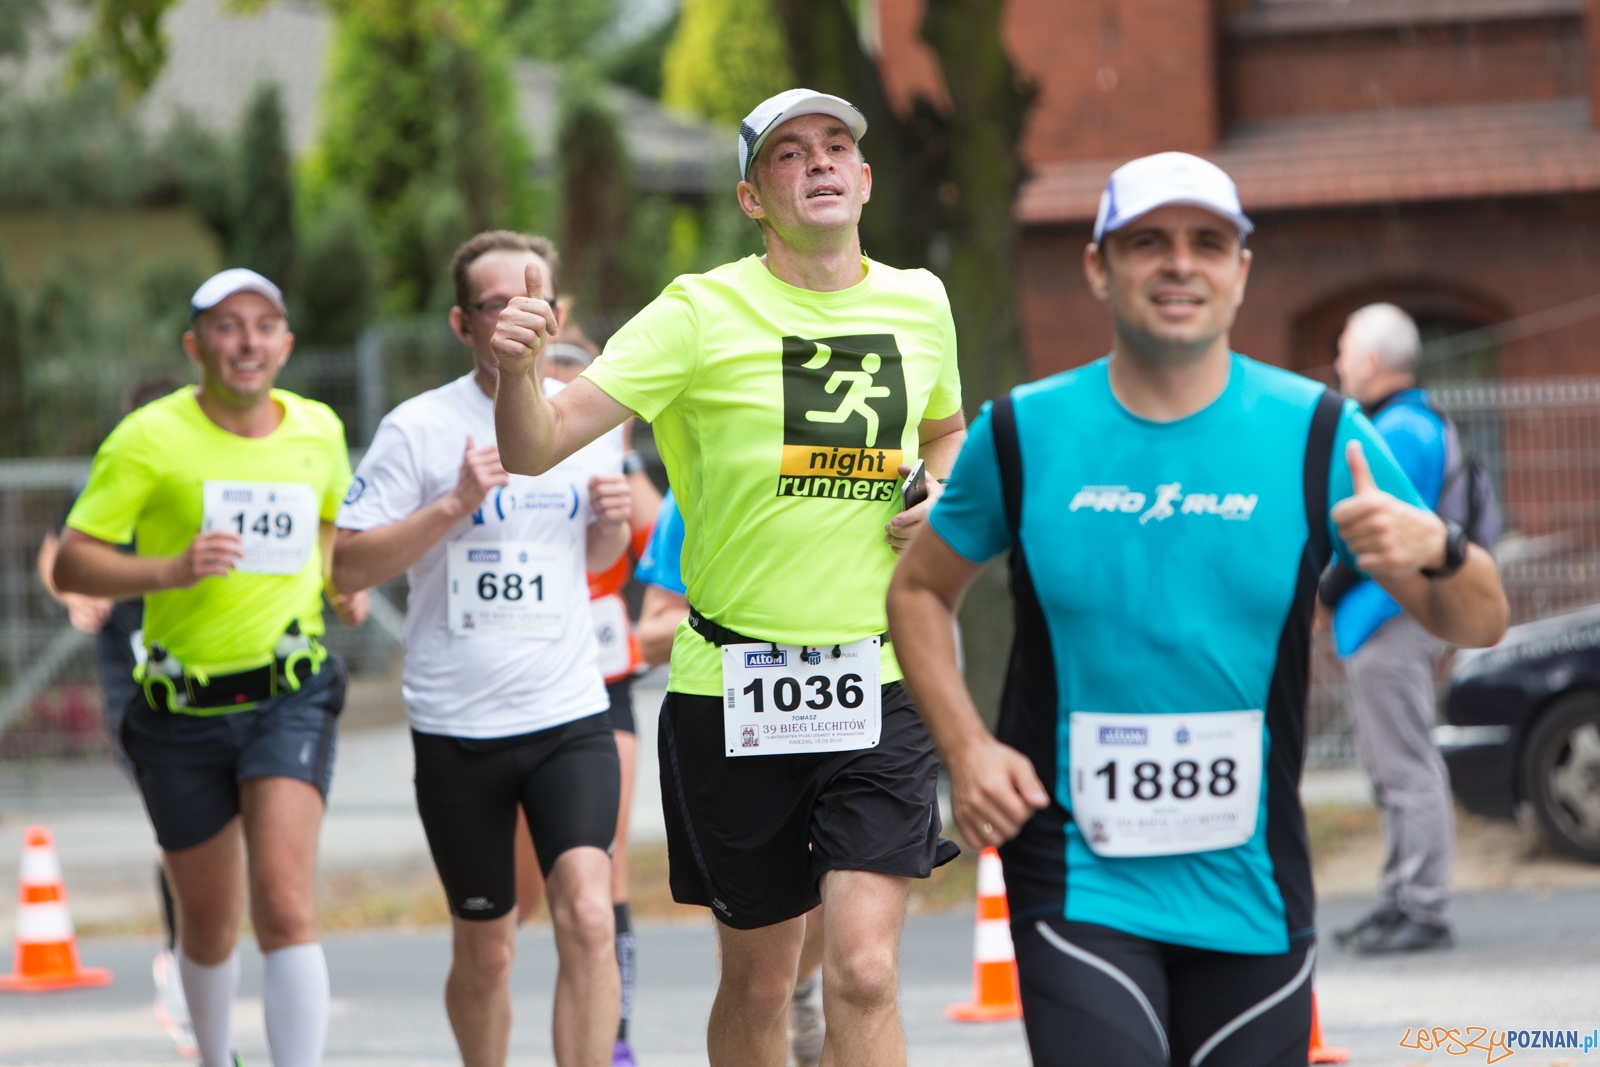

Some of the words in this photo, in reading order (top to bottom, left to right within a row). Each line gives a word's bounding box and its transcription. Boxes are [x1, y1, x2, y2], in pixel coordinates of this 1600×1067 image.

[809, 447, 886, 477] night
[778, 477, 894, 501] runners
[1069, 491, 1146, 513] PRO
[1181, 493, 1259, 515] RUN
[231, 511, 293, 539] 149
[477, 572, 544, 602] 681
[743, 673, 864, 713] 1036
[763, 724, 777, 734] 39
[780, 722, 807, 734] BIEG
[811, 718, 867, 732] LECHITÓW
[792, 714, 817, 722] TOMASZ
[1095, 758, 1238, 801] 1888
